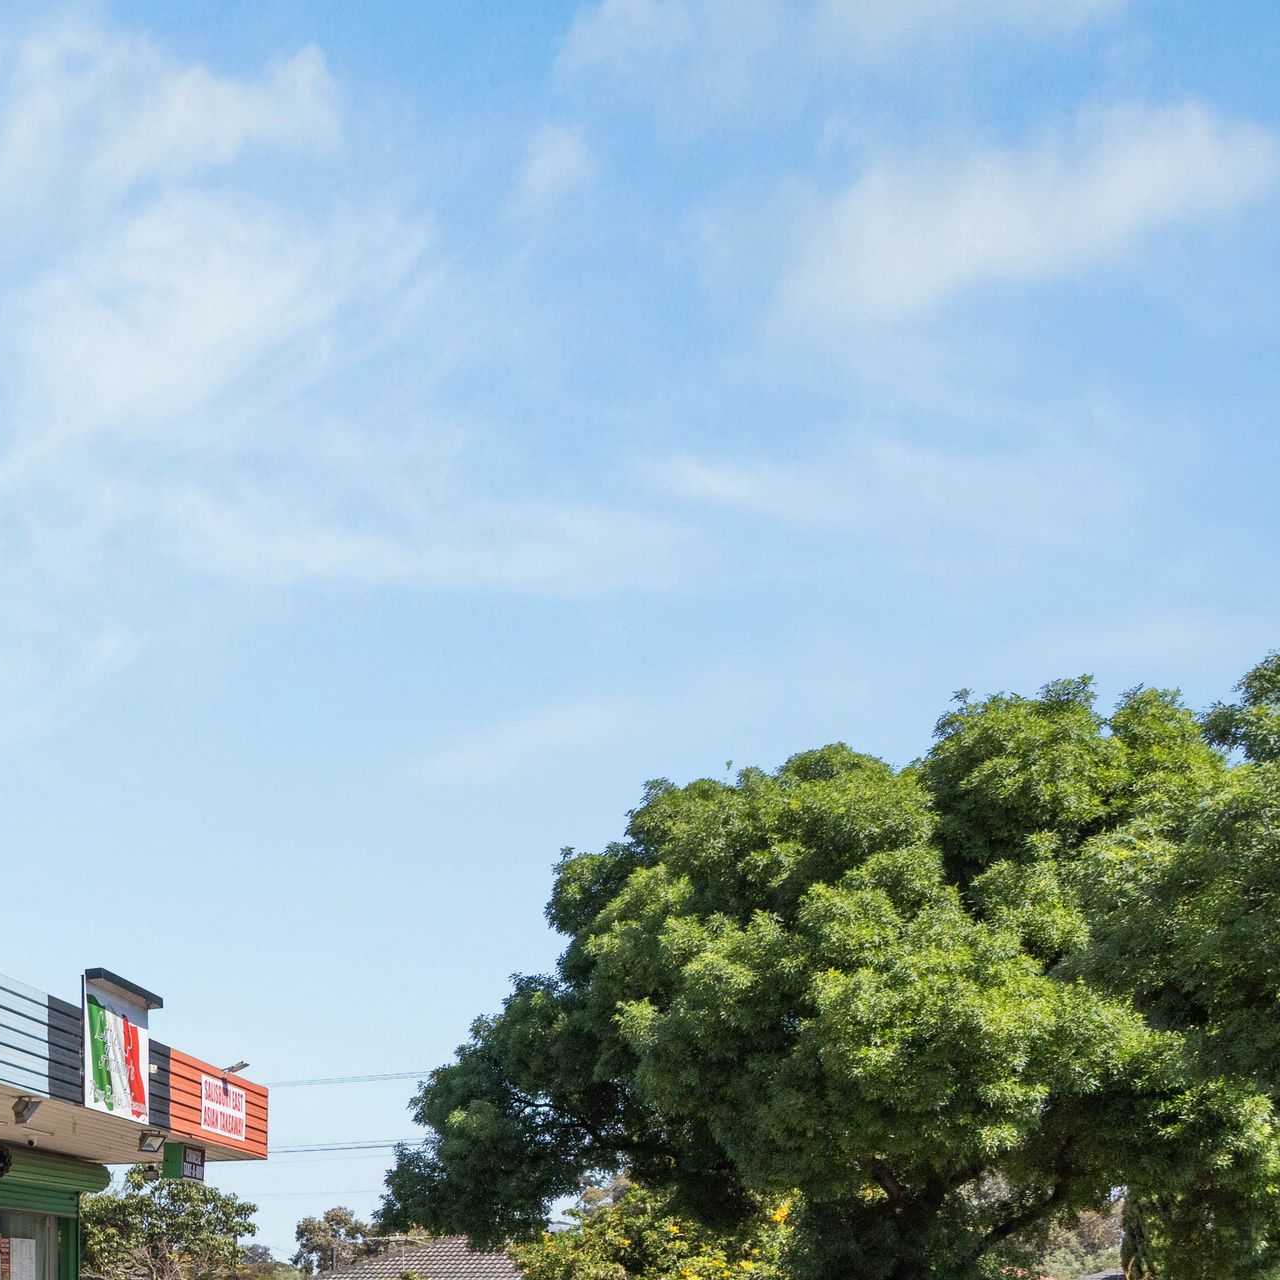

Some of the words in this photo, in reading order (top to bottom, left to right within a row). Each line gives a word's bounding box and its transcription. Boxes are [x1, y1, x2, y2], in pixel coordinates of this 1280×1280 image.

[232, 1090, 243, 1112] EAST
[203, 1103, 218, 1129] ASIAN
[219, 1111, 244, 1138] TAKEAWAY
